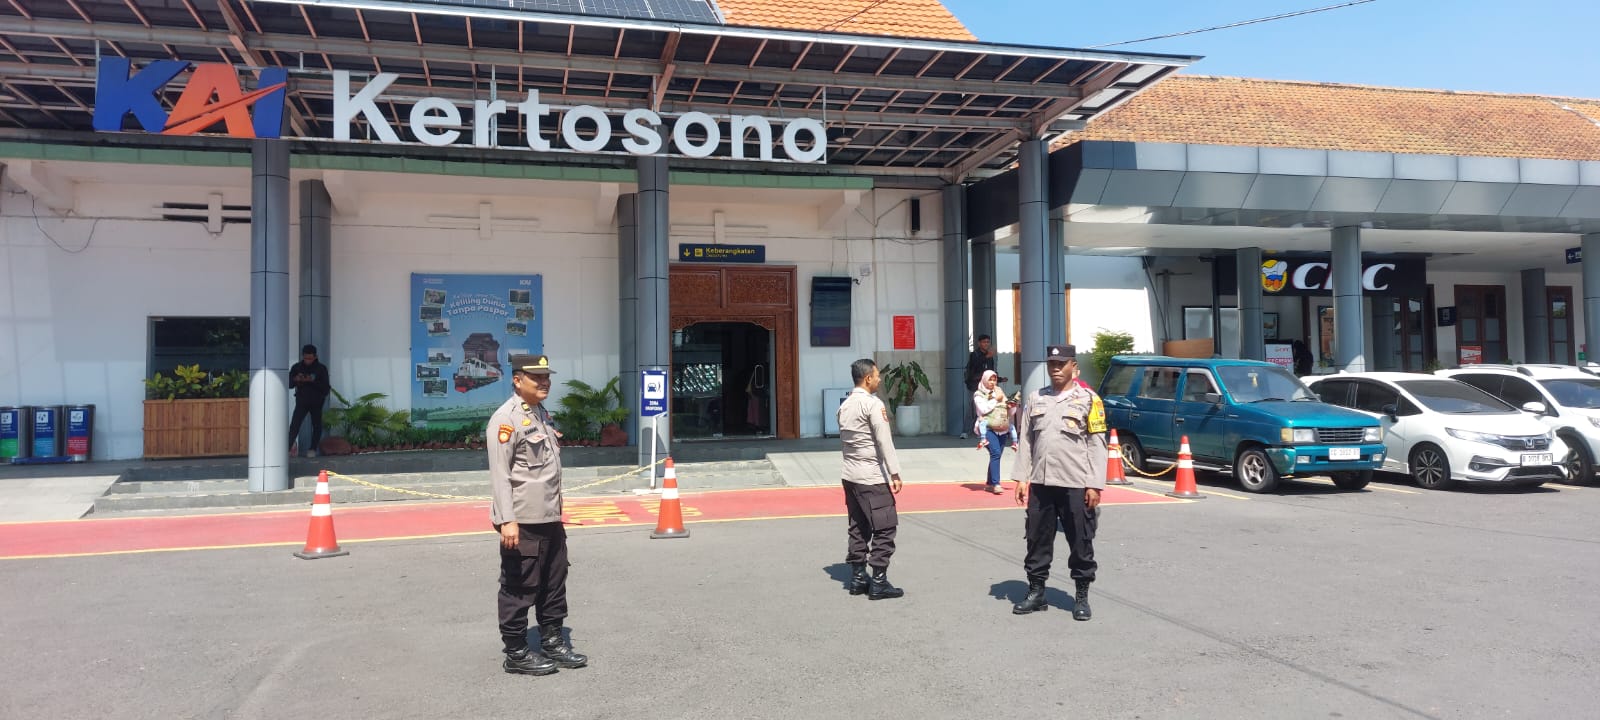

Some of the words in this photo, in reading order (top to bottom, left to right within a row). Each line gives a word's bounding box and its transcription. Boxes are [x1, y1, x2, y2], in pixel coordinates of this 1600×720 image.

[92, 55, 289, 139] KAI
[332, 70, 828, 163] Kertosono
[705, 247, 756, 255] Keberangkatan
[1292, 262, 1396, 291] CC
[446, 305, 476, 316] Tanpa
[477, 304, 509, 317] Paspor
[449, 298, 481, 309] Keliling
[482, 297, 506, 309] Dunia
